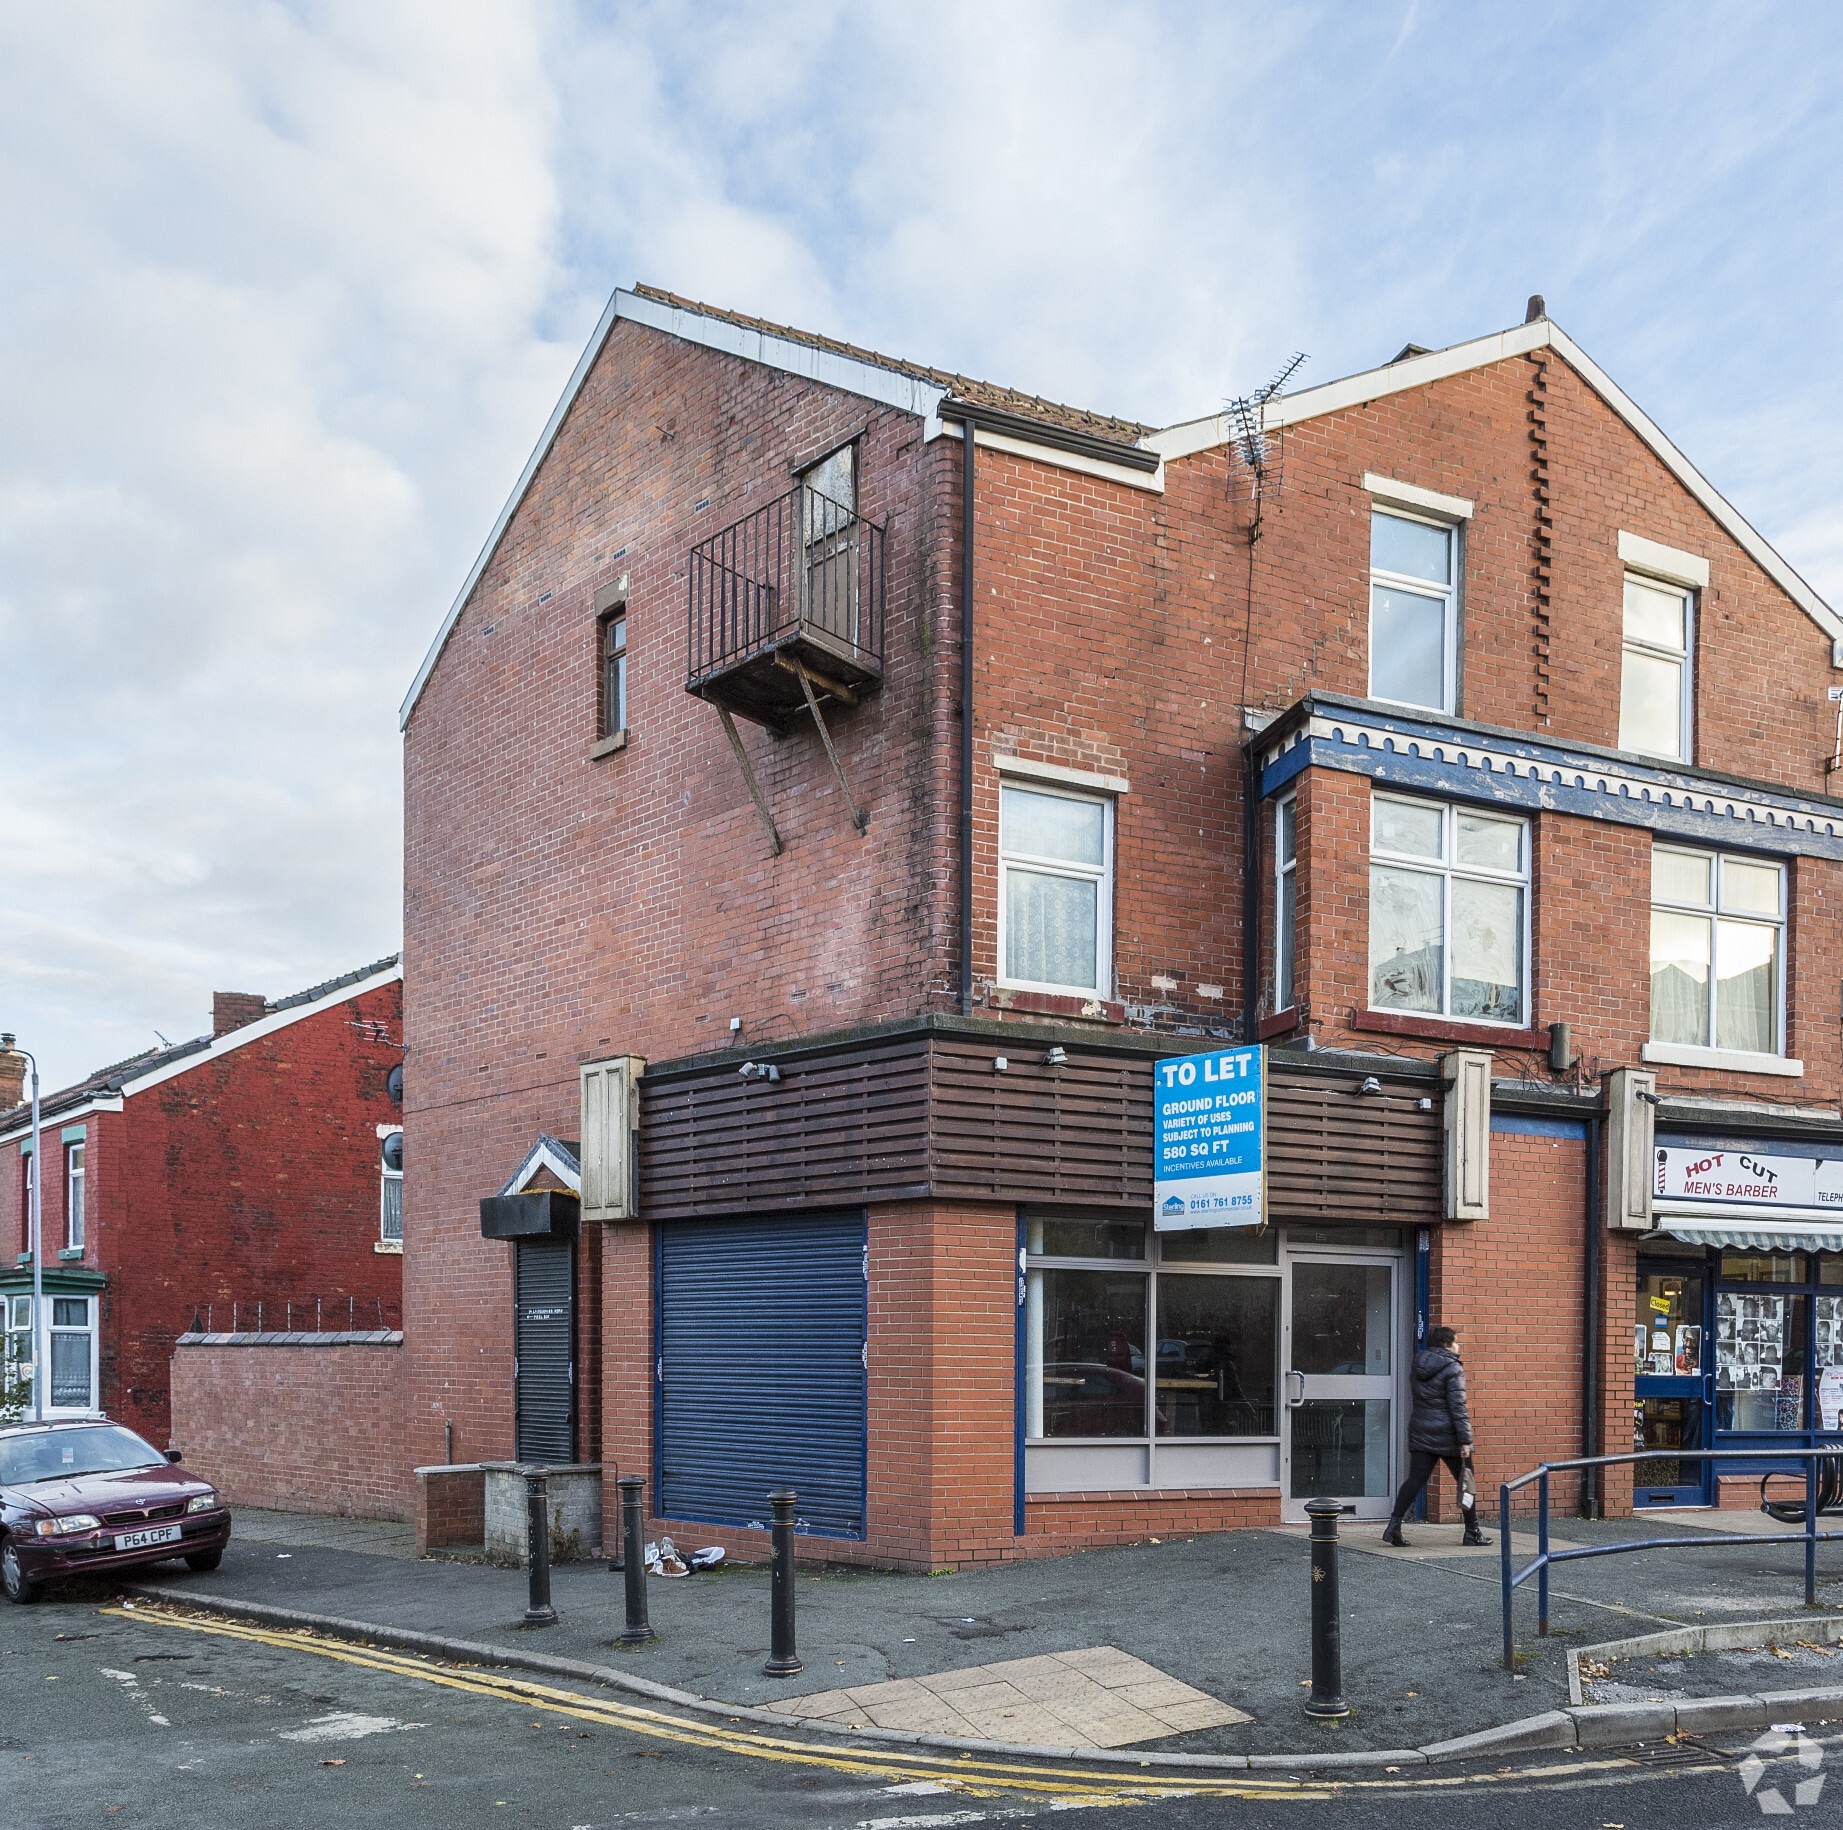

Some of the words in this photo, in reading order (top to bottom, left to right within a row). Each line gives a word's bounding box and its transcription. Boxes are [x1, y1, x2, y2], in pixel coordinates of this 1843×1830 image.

[1162, 1062, 1197, 1088] TO
[1204, 1053, 1252, 1082] LET
[1162, 1098, 1213, 1116] GROUND
[1215, 1090, 1255, 1108] FLOOR
[1163, 1116, 1195, 1130] VARIETY
[1197, 1114, 1208, 1125] OF
[1210, 1111, 1231, 1124] USES
[1162, 1129, 1198, 1143] SUBJECT
[1200, 1127, 1211, 1138] TO
[1213, 1121, 1254, 1136] PLANNING
[1163, 1146, 1187, 1160] 580
[1190, 1142, 1208, 1156] SQ
[1212, 1140, 1229, 1154] FT
[1163, 1161, 1204, 1173] INCENTIVES
[1206, 1156, 1243, 1168] AVAILABLE
[1685, 1153, 1724, 1179] HOT
[1739, 1155, 1778, 1184] CUT
[1683, 1181, 1723, 1196] MEN'S
[1726, 1183, 1778, 1198] BARBER
[1818, 1191, 1843, 1203] TELEPH
[1190, 1199, 1210, 1210] 0161
[1213, 1196, 1228, 1208] 761
[1231, 1194, 1253, 1206] 8755
[1650, 1299, 1670, 1311] Closed
[123, 1532, 148, 1547] P64
[150, 1528, 173, 1542] CPF
